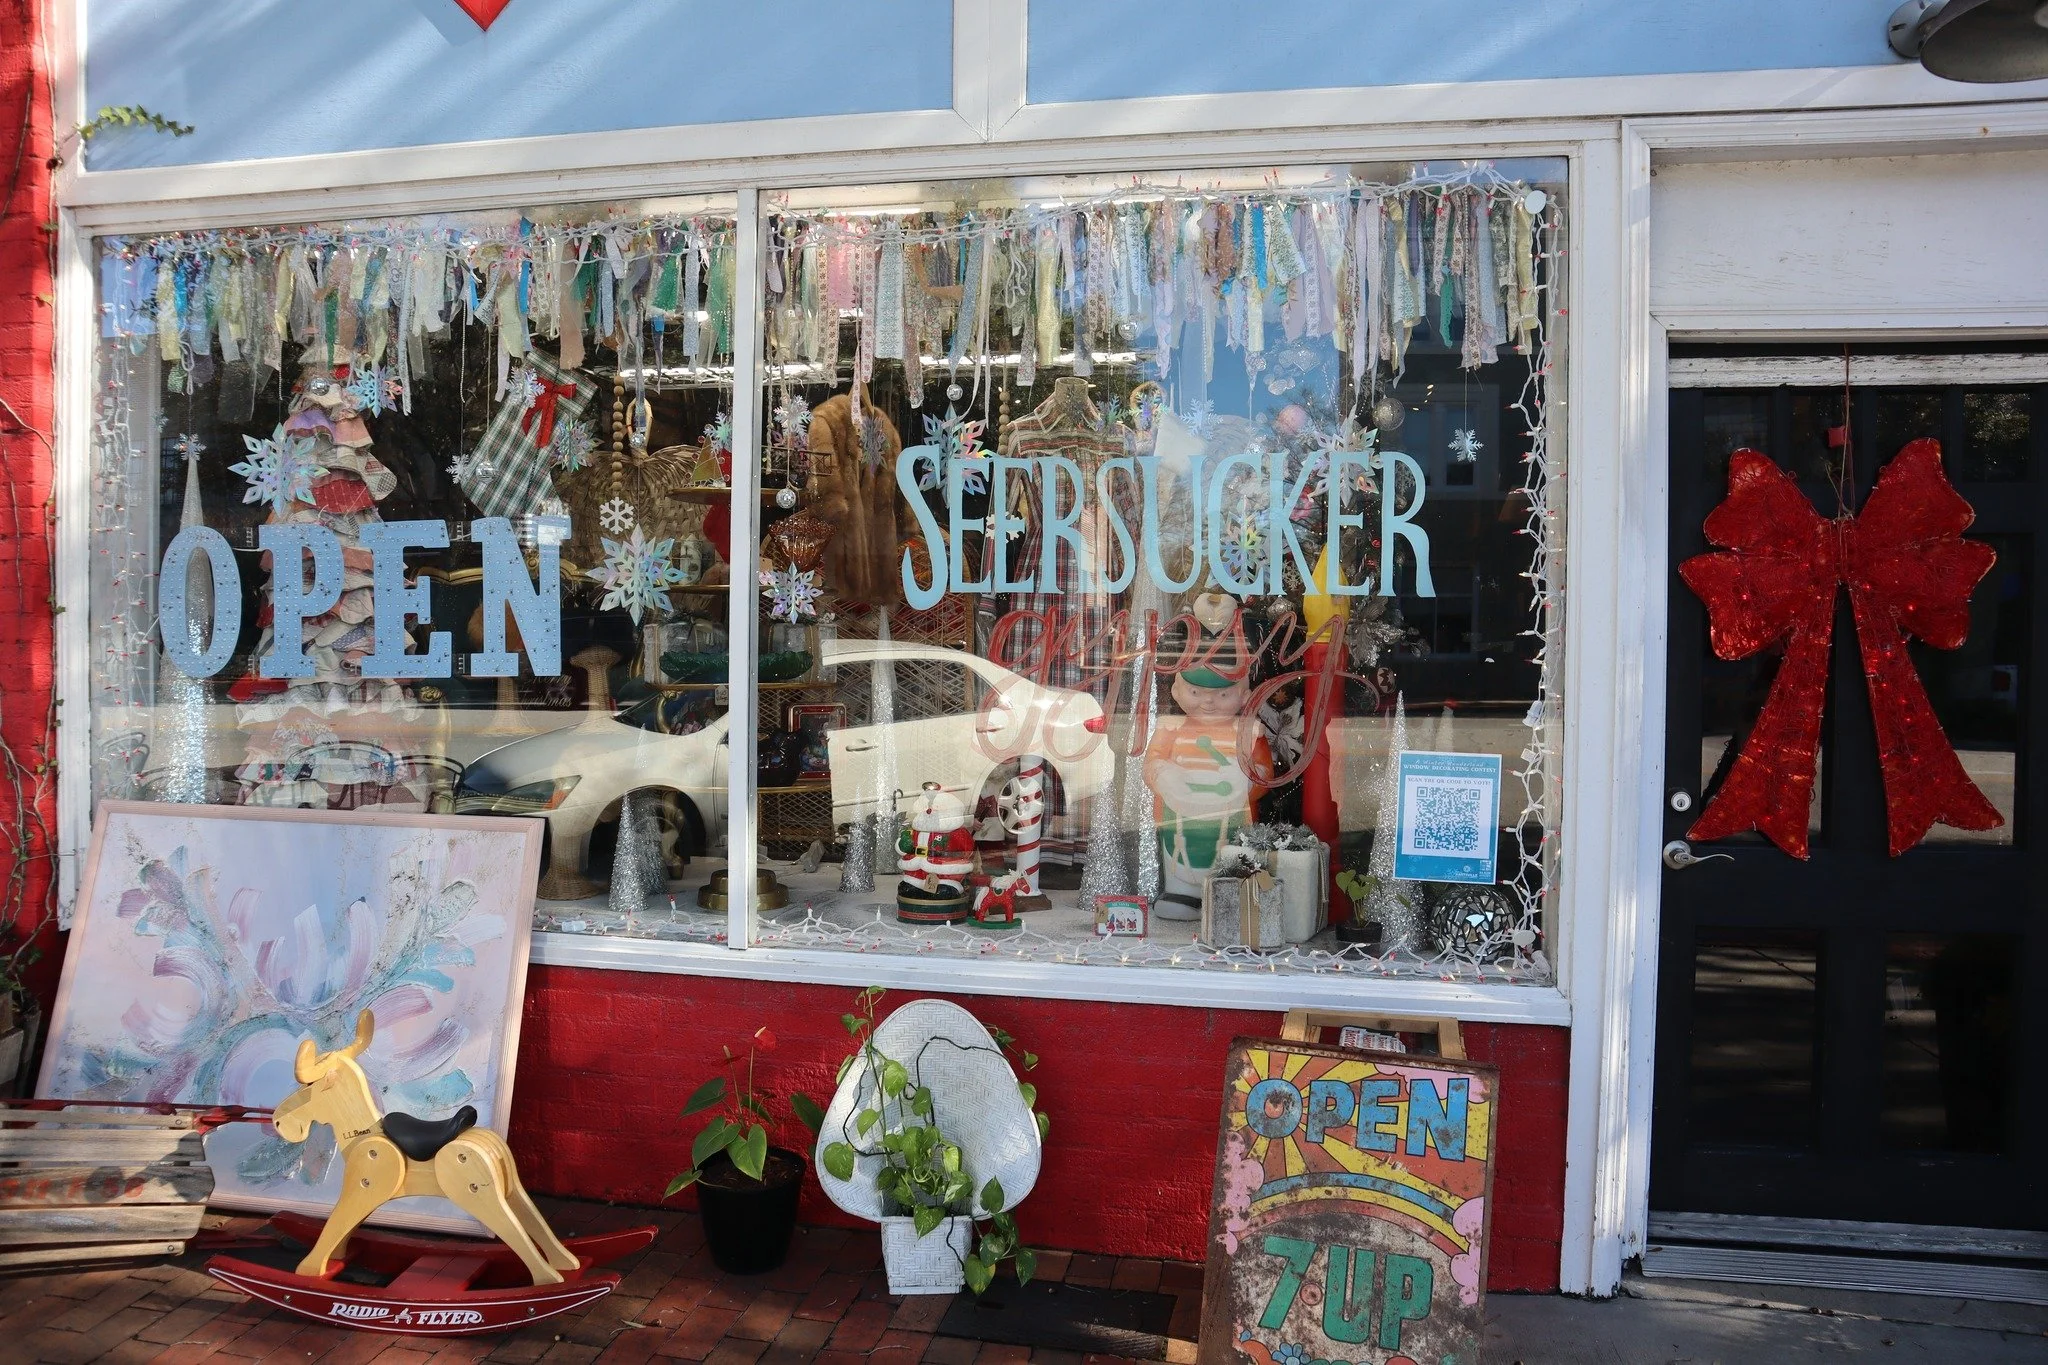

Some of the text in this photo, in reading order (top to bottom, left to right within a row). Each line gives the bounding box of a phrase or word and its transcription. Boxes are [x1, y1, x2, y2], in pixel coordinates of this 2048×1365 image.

[158, 516, 572, 679] OPEN
[896, 444, 1437, 610] SEERSUCKER
[975, 600, 1381, 789] gypsy
[1245, 1077, 1470, 1163] OPEN
[328, 1302, 484, 1325] RADIO FLYER
